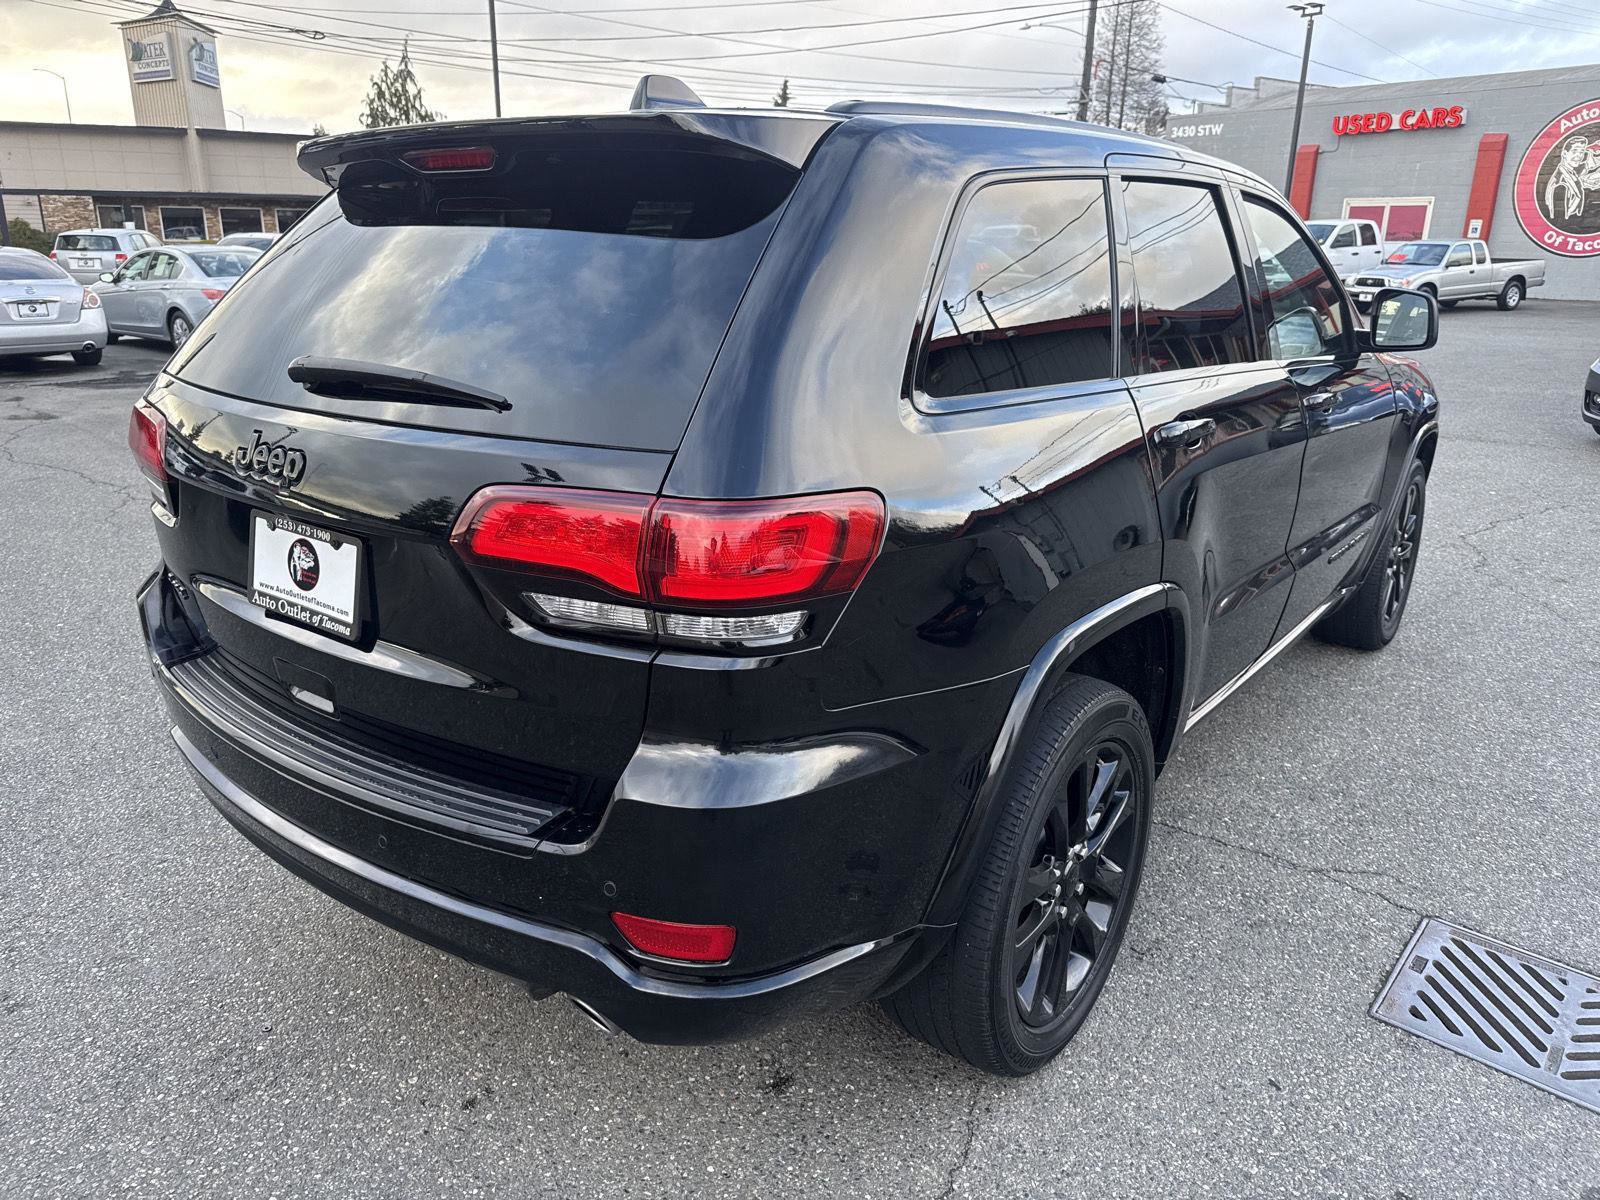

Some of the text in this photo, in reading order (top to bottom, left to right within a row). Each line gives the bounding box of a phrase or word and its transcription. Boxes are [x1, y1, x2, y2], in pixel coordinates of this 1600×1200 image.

[138, 59, 169, 70] CONCEPTS
[1171, 123, 1224, 138] 3430 STW
[1332, 105, 1464, 136] USED CARS
[1559, 106, 1600, 134] Auto
[1543, 230, 1566, 248] Of
[233, 429, 307, 489] Jeep
[275, 518, 331, 542] (253) 473-1900
[252, 591, 351, 636] Auto Outlet of Tacoma
[259, 582, 350, 617] www.AutoOutletofTacoma.com
